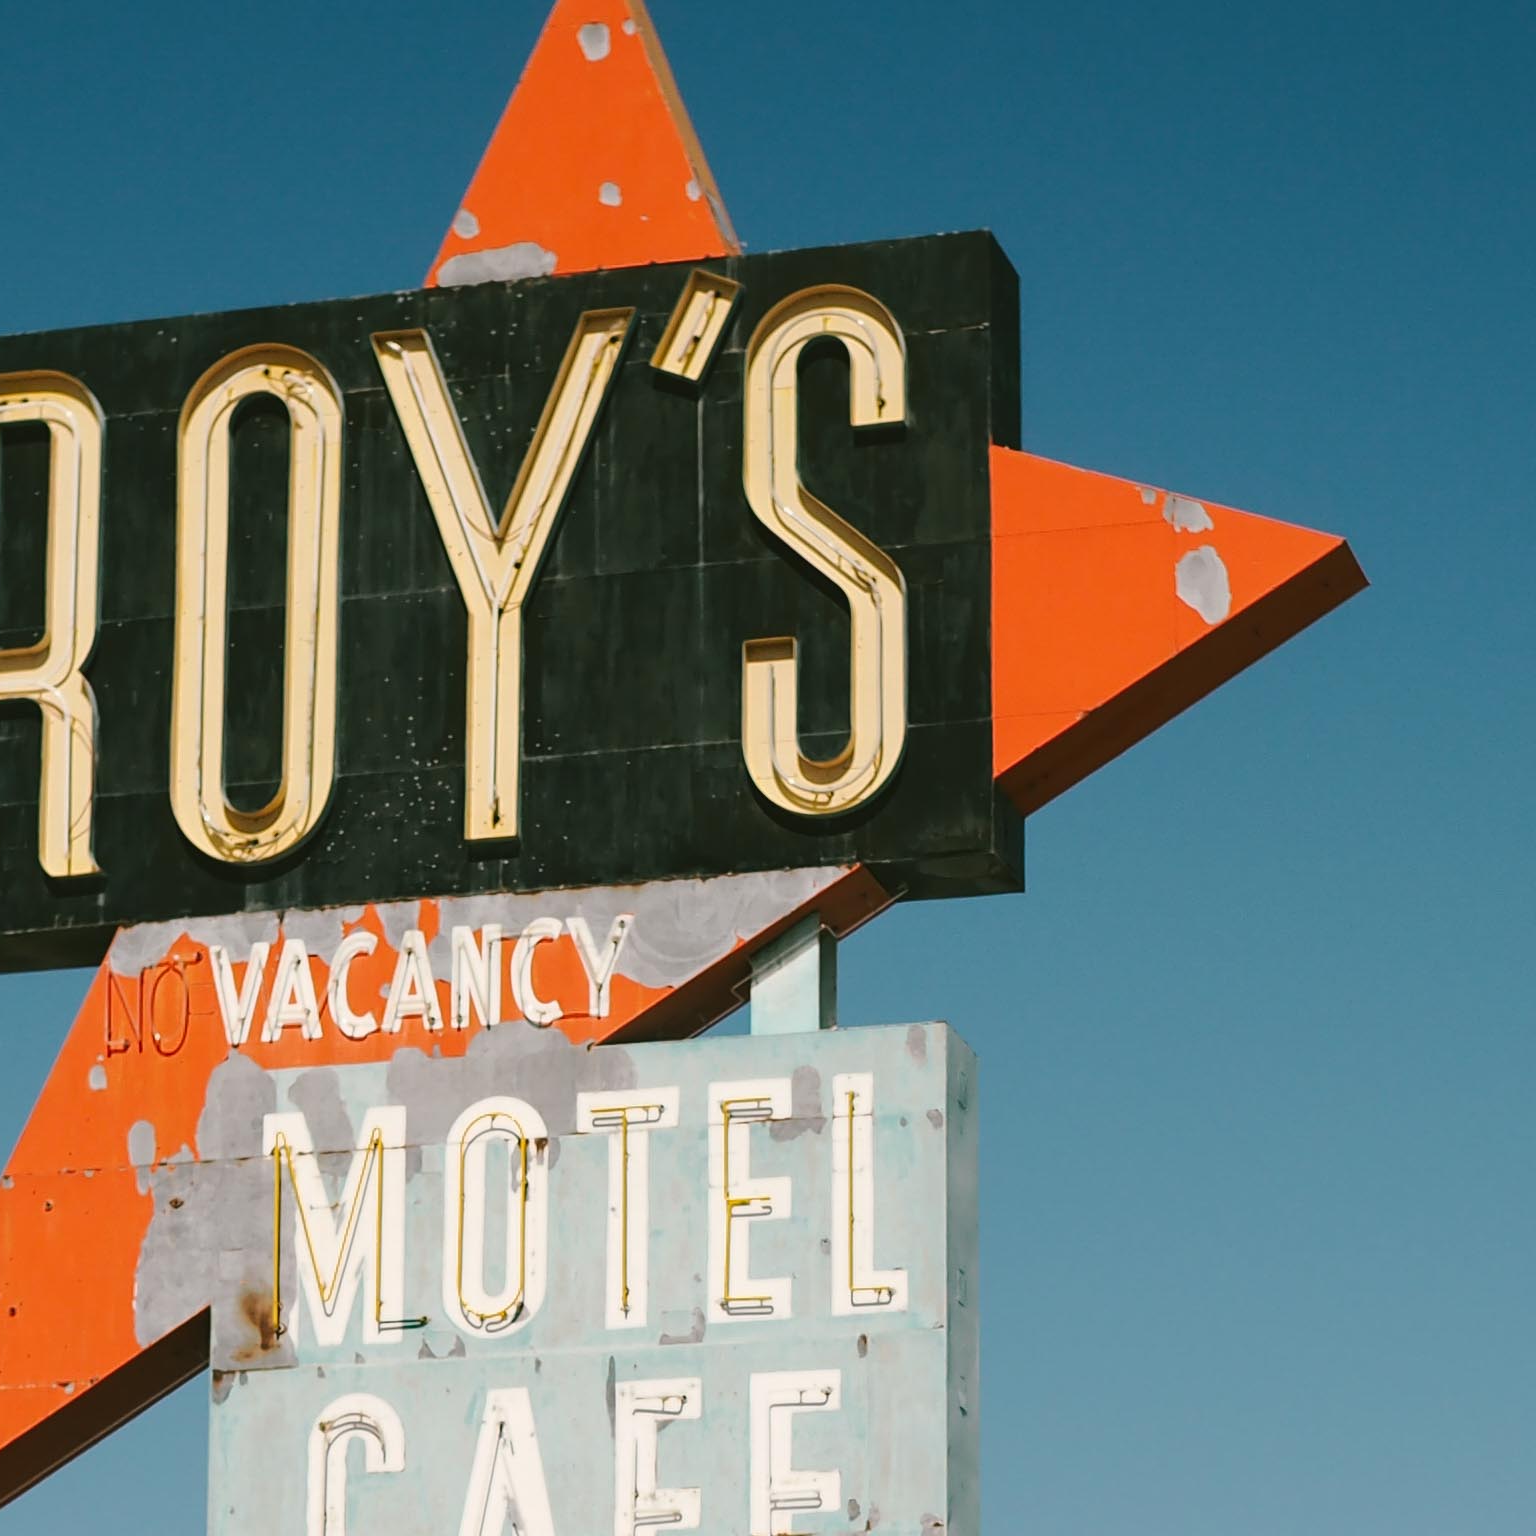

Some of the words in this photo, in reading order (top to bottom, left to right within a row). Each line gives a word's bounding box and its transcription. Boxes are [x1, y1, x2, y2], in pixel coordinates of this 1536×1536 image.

[105, 958, 190, 1057] NO
[209, 913, 635, 1047] VACANCY
[263, 1072, 909, 1347] MOTEL
